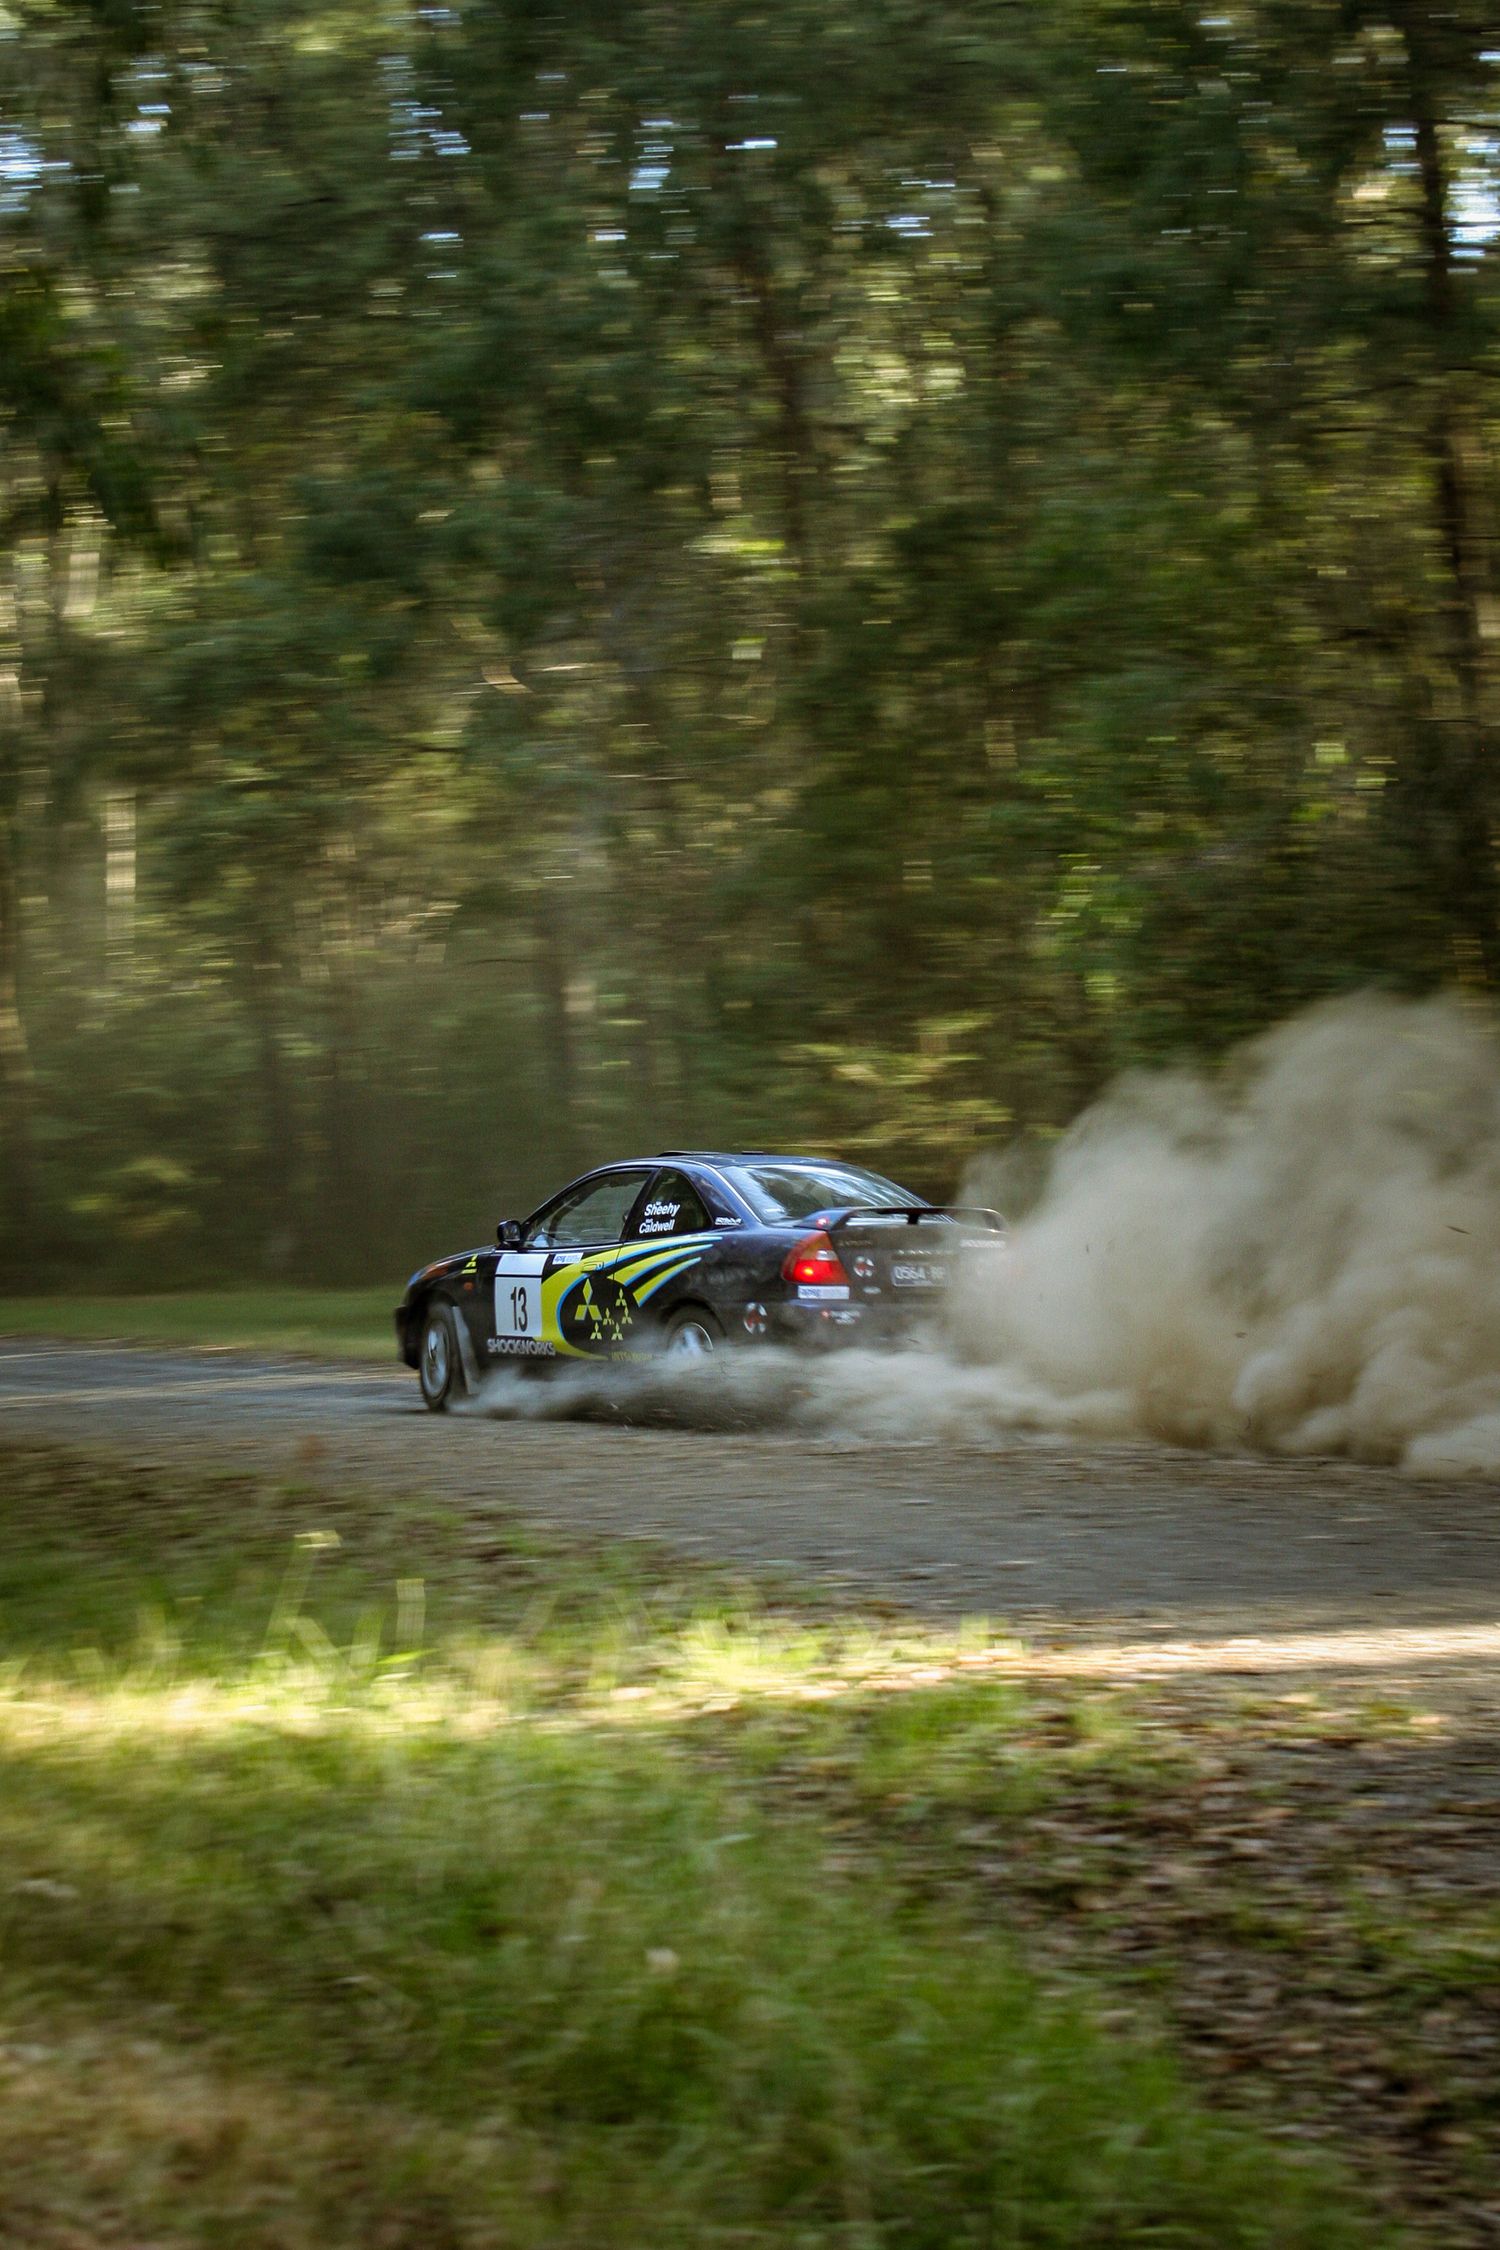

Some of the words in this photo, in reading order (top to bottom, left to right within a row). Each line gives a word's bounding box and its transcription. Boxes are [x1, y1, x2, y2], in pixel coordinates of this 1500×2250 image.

[644, 1202, 681, 1217] Sheehy
[639, 1219, 676, 1234] Caldwell
[510, 1286, 528, 1332] 13
[487, 1338, 556, 1356] SHOCKWORKS
